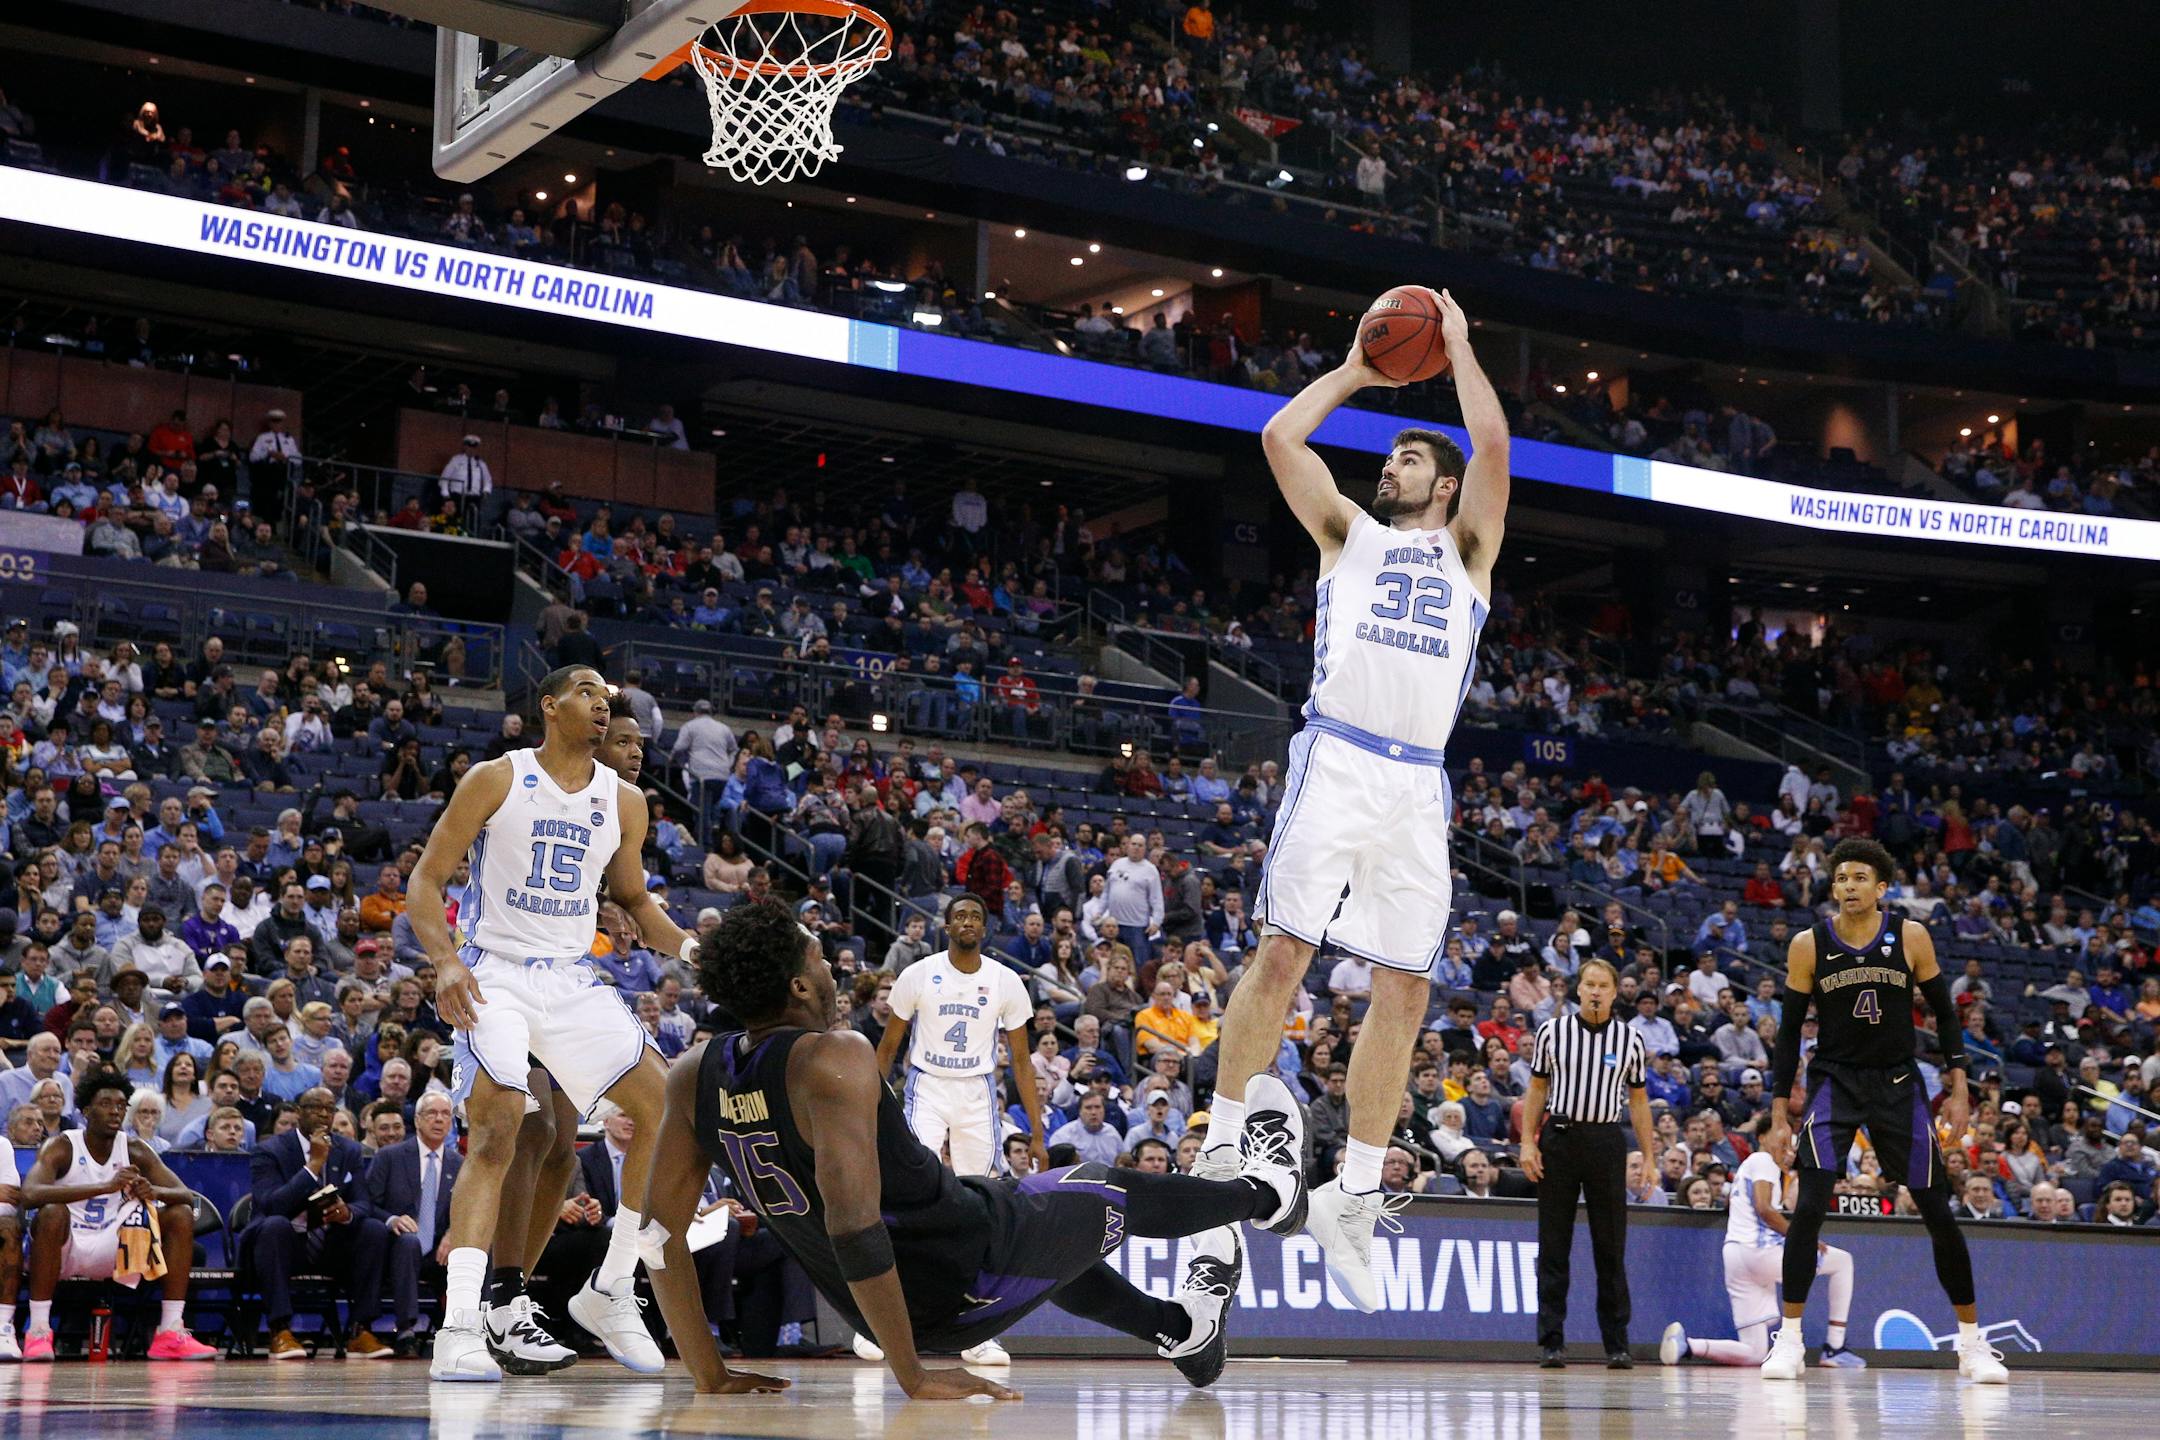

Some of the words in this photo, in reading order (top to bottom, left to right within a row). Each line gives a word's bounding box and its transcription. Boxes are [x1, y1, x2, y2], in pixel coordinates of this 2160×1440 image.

[201, 214, 386, 271] WASHINGTON
[395, 249, 428, 279] VS
[435, 257, 525, 296] NORTH
[532, 274, 654, 319] CAROLINA
[1234, 523, 1258, 543] C5
[1791, 494, 1912, 527] WASHINGTON
[1919, 509, 1943, 530] VS
[1949, 511, 2012, 537] NORTH
[2019, 518, 2109, 546] CAROLINA
[1371, 571, 1452, 631] 32
[1675, 590, 1698, 609] C6
[1355, 622, 1450, 659] CAROLINA
[1532, 739, 1567, 762] 105
[531, 819, 591, 847] NORTH
[525, 841, 586, 892] 15
[505, 888, 590, 917] CAROLINA
[1819, 966, 1907, 994] WASHINGTON
[938, 1003, 980, 1020] NORTH
[1853, 989, 1882, 1025] 4
[943, 1020, 968, 1053] 4
[924, 1051, 980, 1069] CAROLINA
[718, 1128, 810, 1217] 15
[84, 1197, 109, 1224] 5
[1838, 1195, 1880, 1216] POSS
